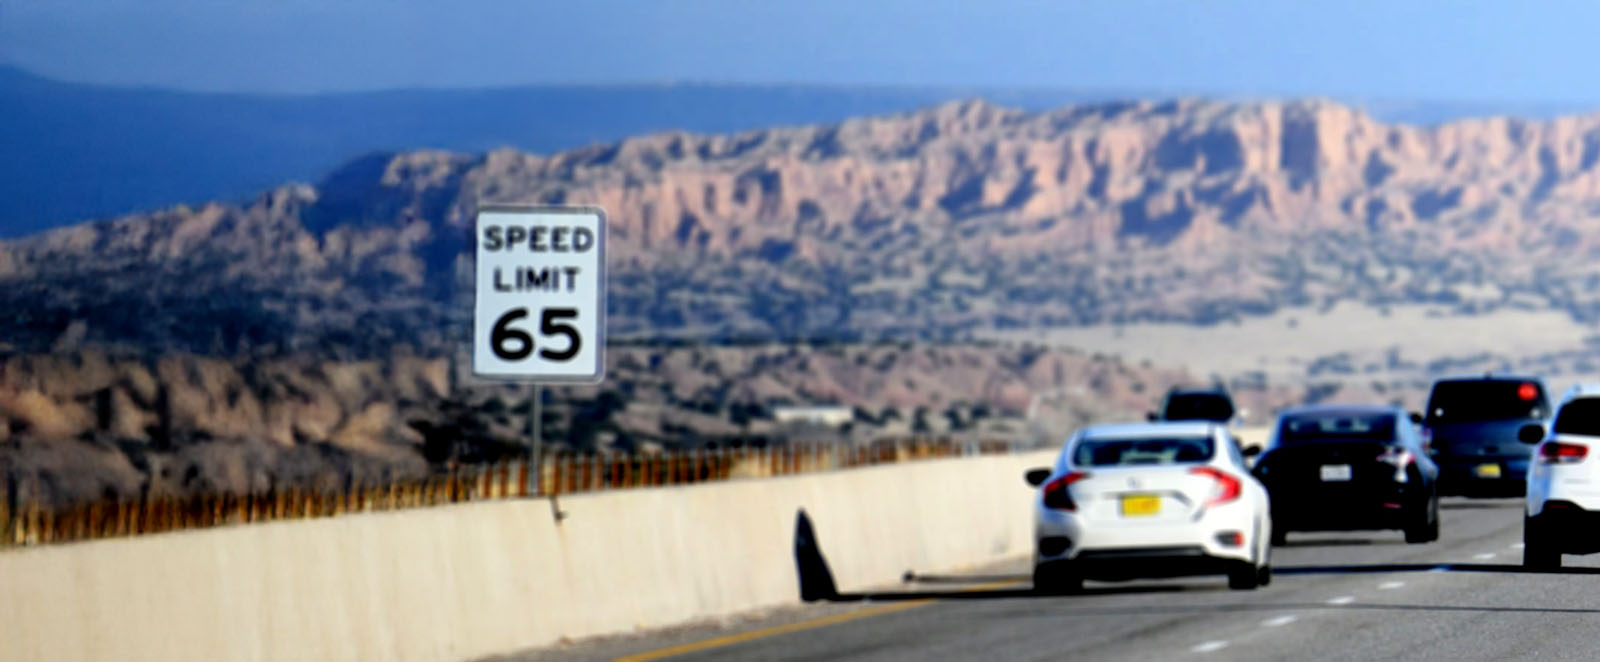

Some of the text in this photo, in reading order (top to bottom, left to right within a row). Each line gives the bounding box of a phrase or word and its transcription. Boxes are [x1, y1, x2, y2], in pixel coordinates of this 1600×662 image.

[483, 226, 594, 252] SPEED
[493, 266, 581, 292] LIMIT
[490, 307, 581, 361] 65
